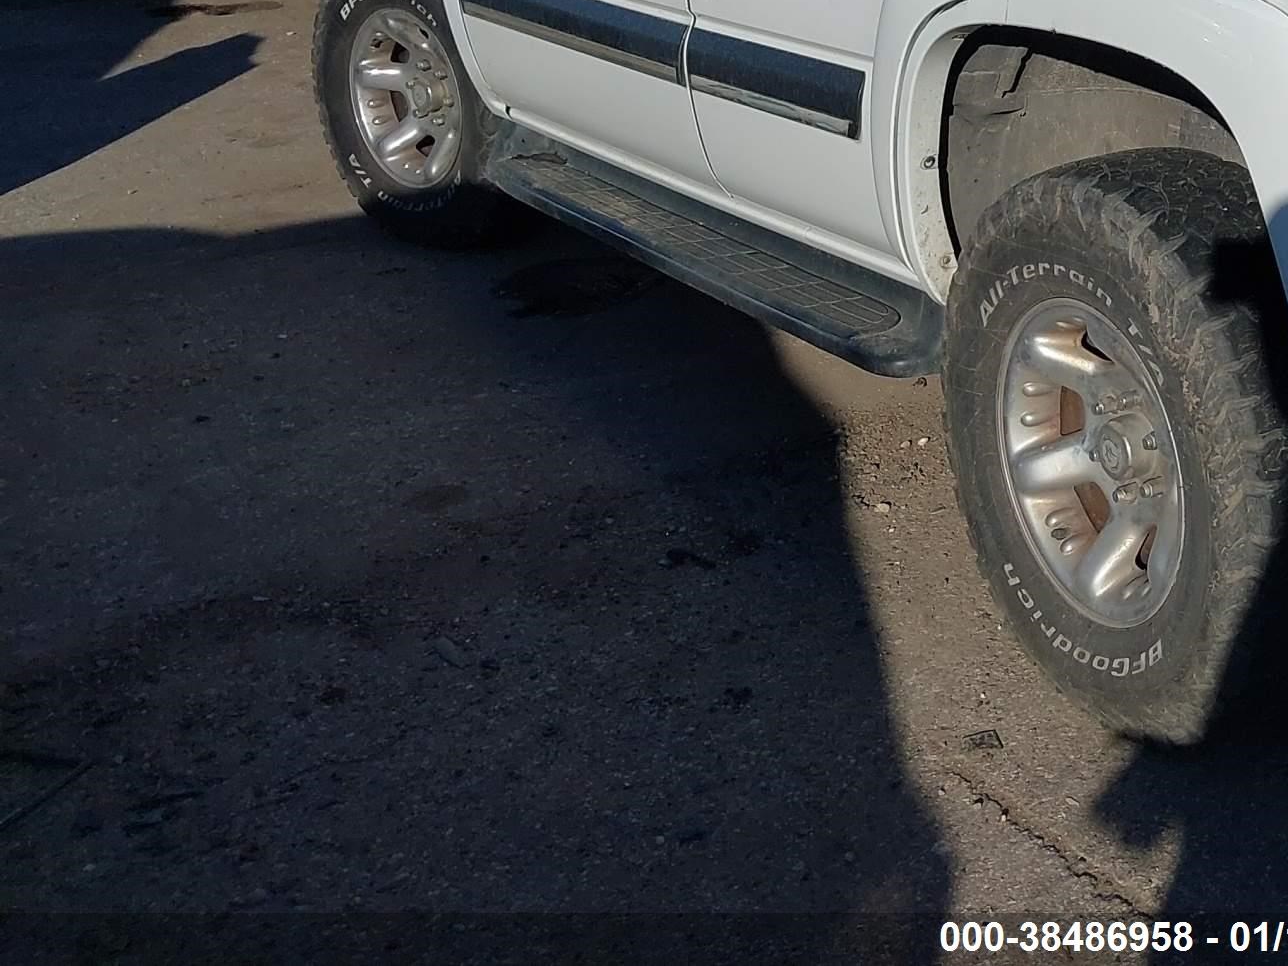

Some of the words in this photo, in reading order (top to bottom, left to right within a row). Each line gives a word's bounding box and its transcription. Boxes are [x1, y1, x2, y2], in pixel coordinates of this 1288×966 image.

[979, 262, 1112, 327] All-Terrain
[1128, 317, 1164, 386] T/A
[1003, 563, 1163, 677] BFGoodrich
